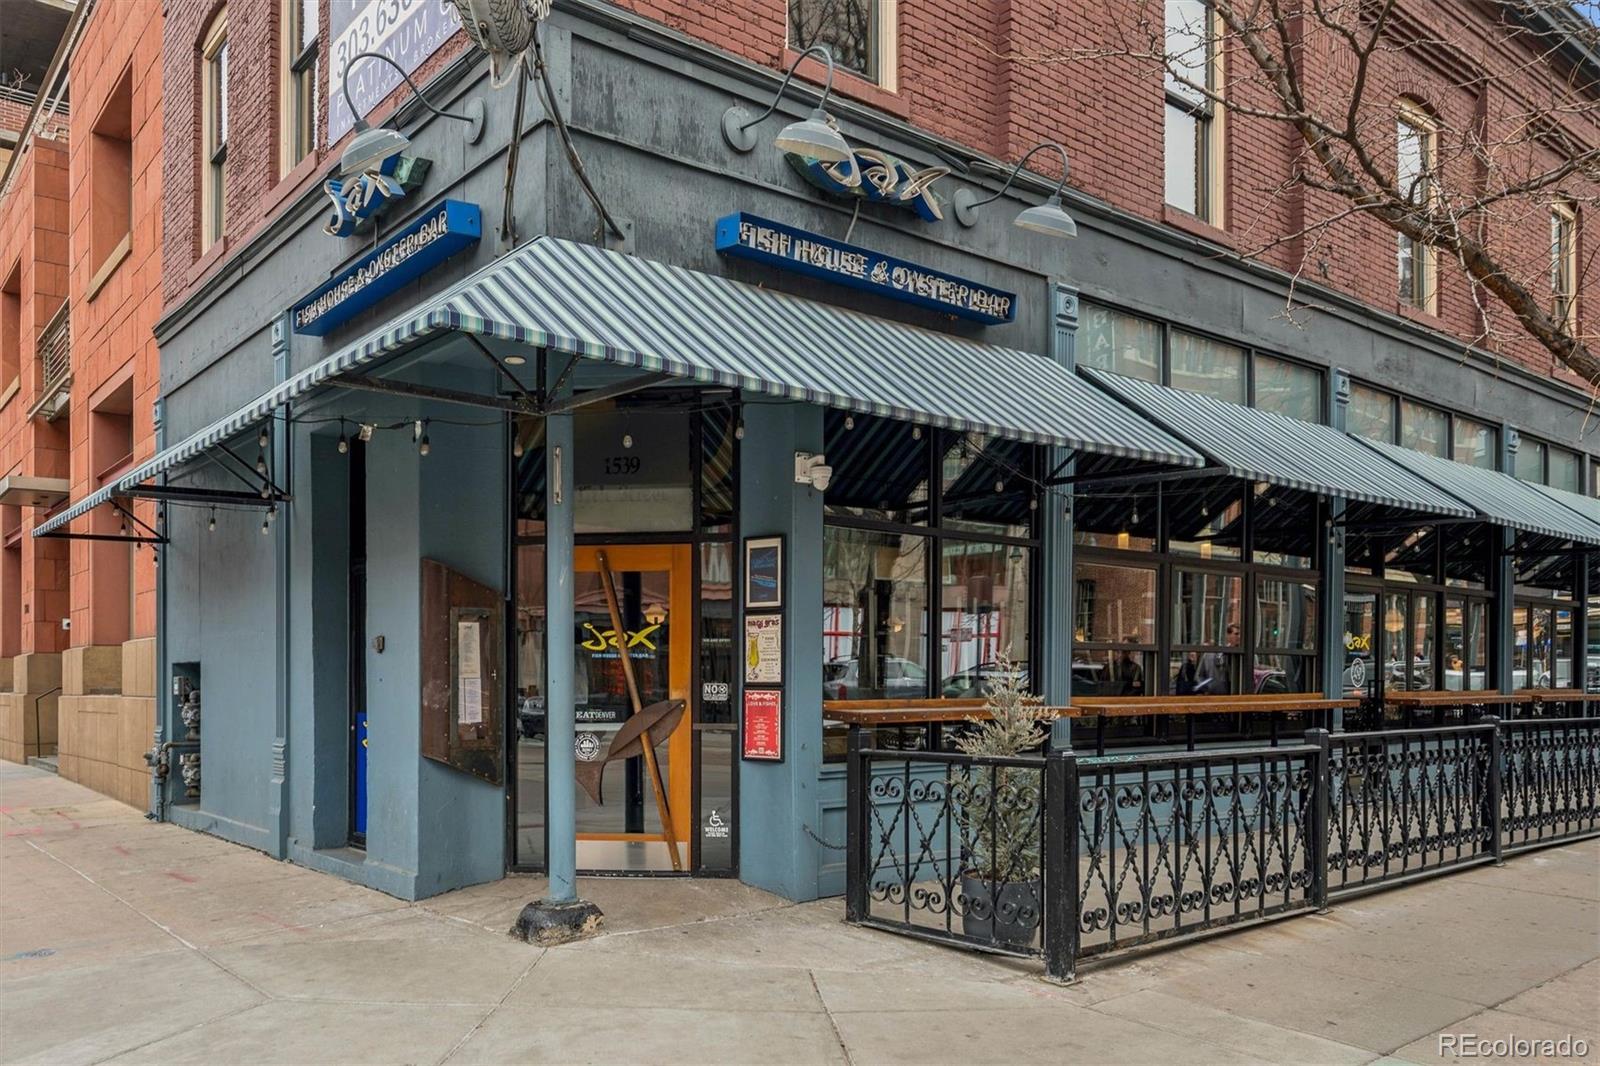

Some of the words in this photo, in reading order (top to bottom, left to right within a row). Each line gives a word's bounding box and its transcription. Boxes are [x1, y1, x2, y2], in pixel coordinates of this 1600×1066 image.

[337, 0, 412, 79] 303.63
[296, 299, 318, 327] FISH
[316, 275, 355, 314] HOUSE
[415, 210, 449, 246] BAR
[740, 222, 792, 257] FISH
[793, 239, 869, 279] HOUSE
[870, 260, 889, 285] &
[892, 267, 969, 307] OYSTER
[968, 289, 1011, 319] BAR
[605, 456, 641, 475] 1539
[704, 685, 718, 694] NO
